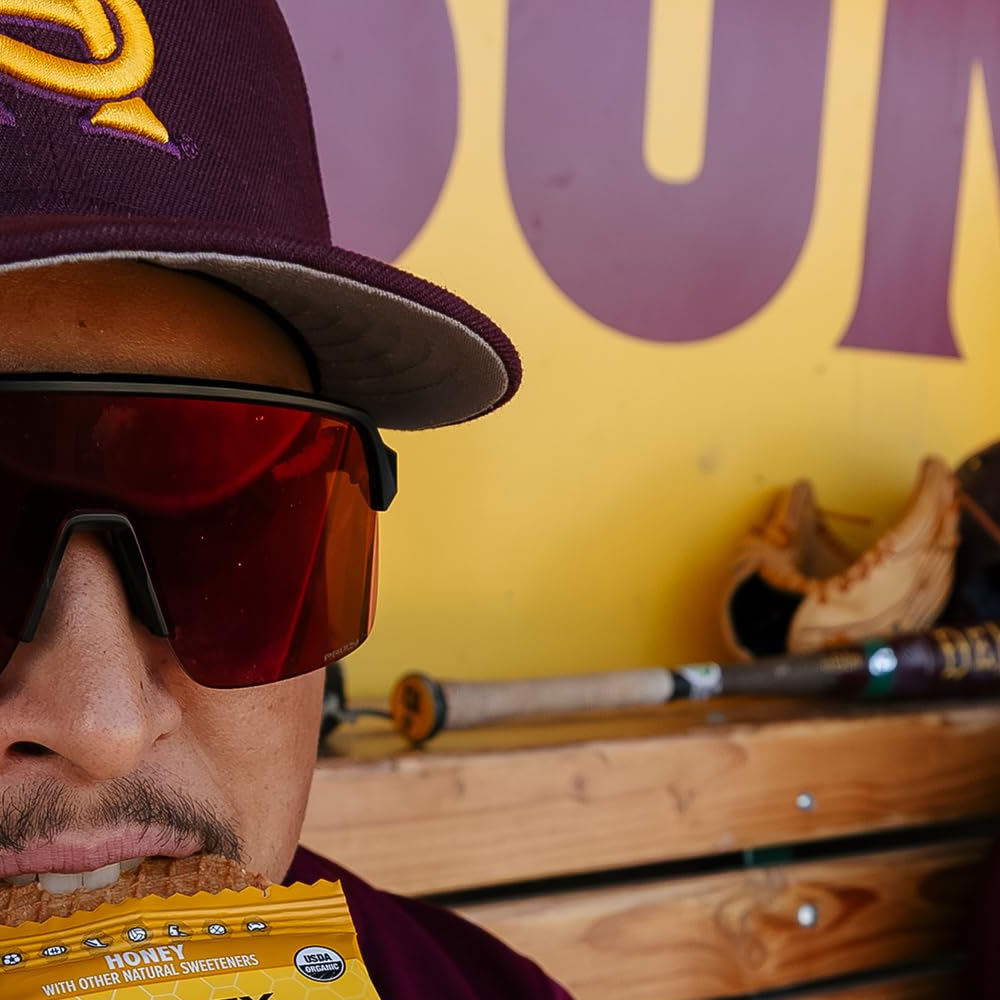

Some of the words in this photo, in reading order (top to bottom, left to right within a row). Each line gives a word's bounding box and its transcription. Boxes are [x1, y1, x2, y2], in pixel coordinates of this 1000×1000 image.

[104, 944, 186, 970] HONEY
[303, 953, 333, 963] USDA
[42, 979, 76, 997] WITH
[79, 972, 120, 990] OTHER
[122, 963, 180, 983] NATURAL
[182, 954, 259, 974] SWEETENERS
[304, 963, 340, 973] ORGANIC
